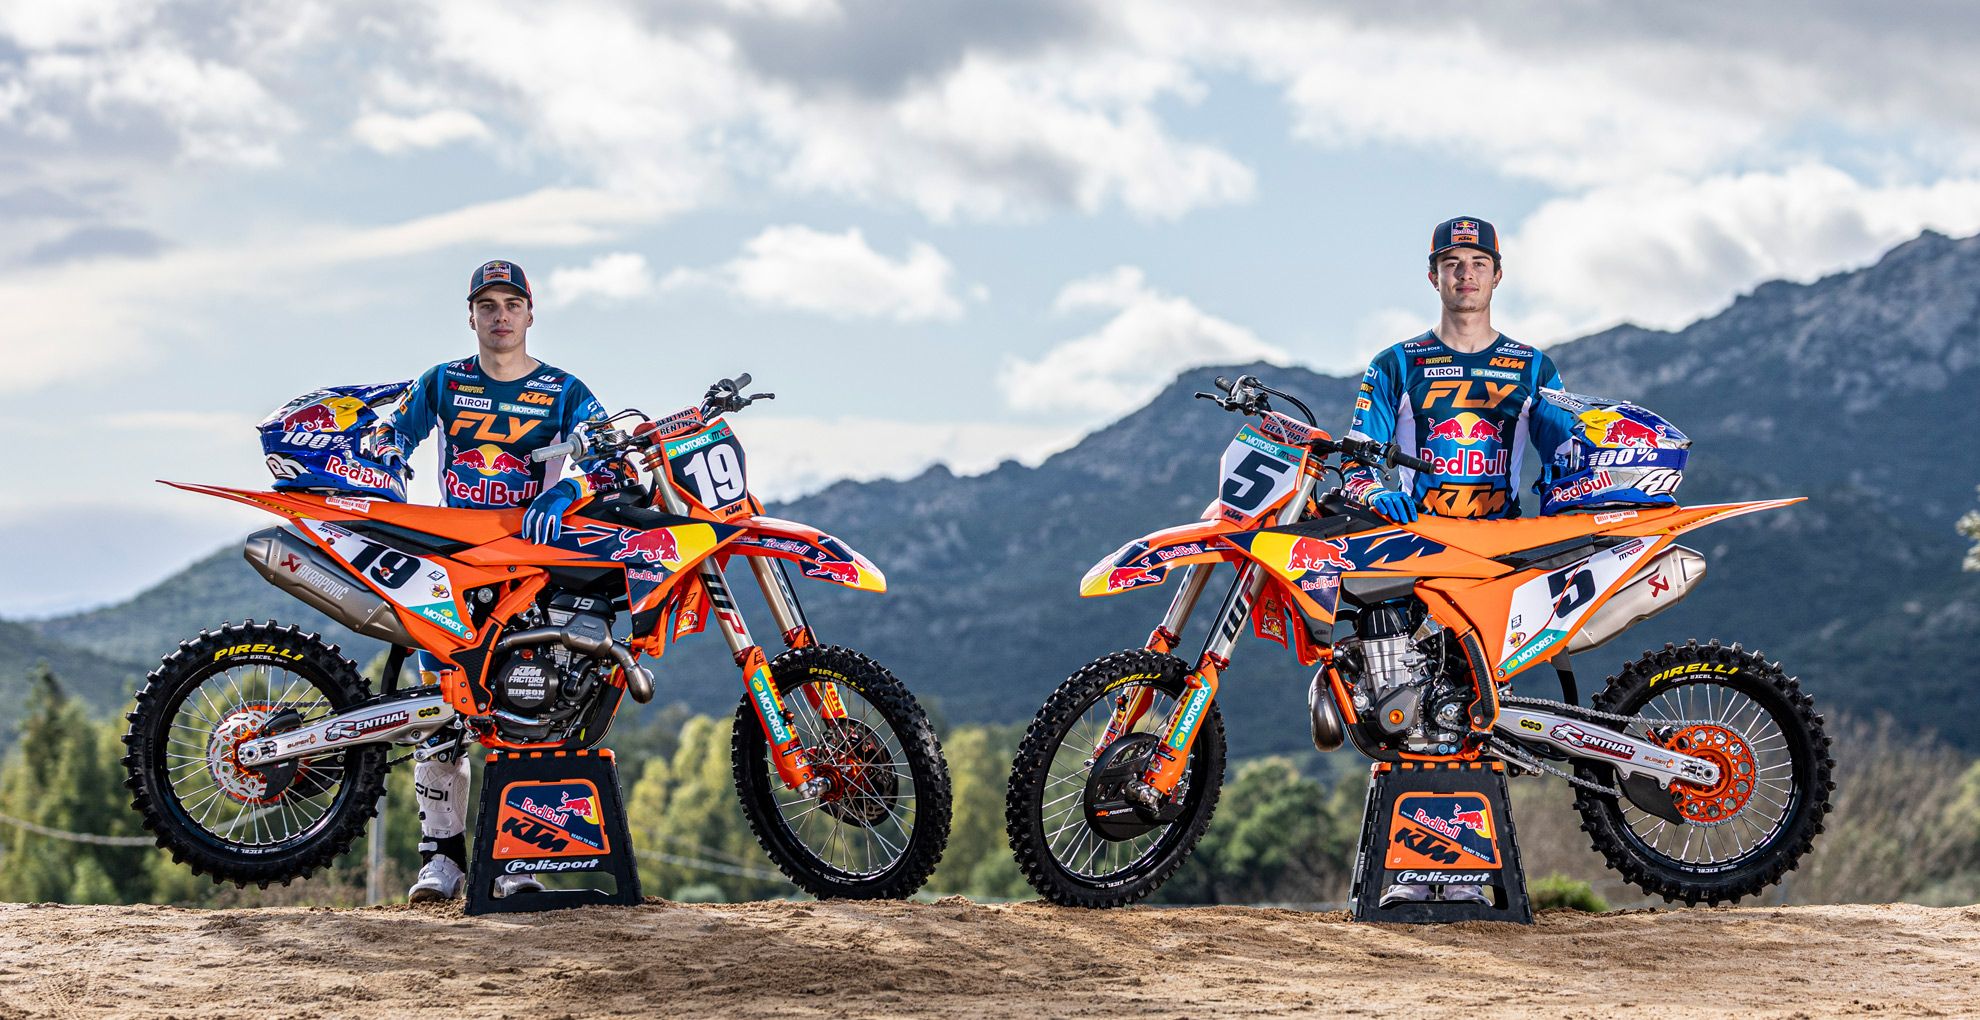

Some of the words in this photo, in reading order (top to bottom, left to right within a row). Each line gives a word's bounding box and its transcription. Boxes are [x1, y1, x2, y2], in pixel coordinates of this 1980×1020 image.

[1427, 368, 1461, 377] AIROH
[1489, 356, 1526, 370] KTM
[1484, 370, 1518, 380] MOTOREX
[456, 397, 490, 408] AIROH
[517, 391, 555, 406] KTM
[1421, 380, 1518, 409] FLY
[1550, 393, 1584, 409] AIROH
[512, 404, 546, 416] MOTOREX
[655, 409, 695, 426] RENTHAL
[449, 410, 542, 444] FLY
[280, 431, 354, 450] 100%
[676, 434, 711, 453] MOTOREX
[1245, 434, 1280, 455] MOTOREX
[1588, 447, 1658, 467] 100%
[683, 443, 744, 510] 19
[1222, 449, 1291, 511] 5
[1422, 483, 1506, 517] KTM
[725, 505, 743, 516] KTM
[1223, 508, 1243, 521] KTM
[350, 538, 422, 590] 19
[1547, 561, 1596, 619] 5
[572, 597, 595, 610] 19
[423, 606, 463, 632] MOTOREX
[213, 643, 305, 661] PIRELLI
[1516, 633, 1556, 663] MOTOREX
[508, 675, 545, 684] FACTORY
[512, 665, 542, 676] KTM
[809, 667, 865, 692] PIRELLI
[1649, 663, 1739, 687] PIRELLI
[1103, 673, 1161, 693] PIRELLI
[758, 691, 787, 742] MOTOREX
[1180, 683, 1211, 733] MOTOREX
[501, 816, 570, 852] KTM
[571, 833, 583, 841] READY
[588, 840, 599, 848] RACE
[1394, 827, 1462, 864] KTM
[1462, 846, 1475, 854] READY
[1480, 853, 1490, 861] RACE
[508, 858, 600, 873] Polisport
[1400, 871, 1490, 883] Polisport
